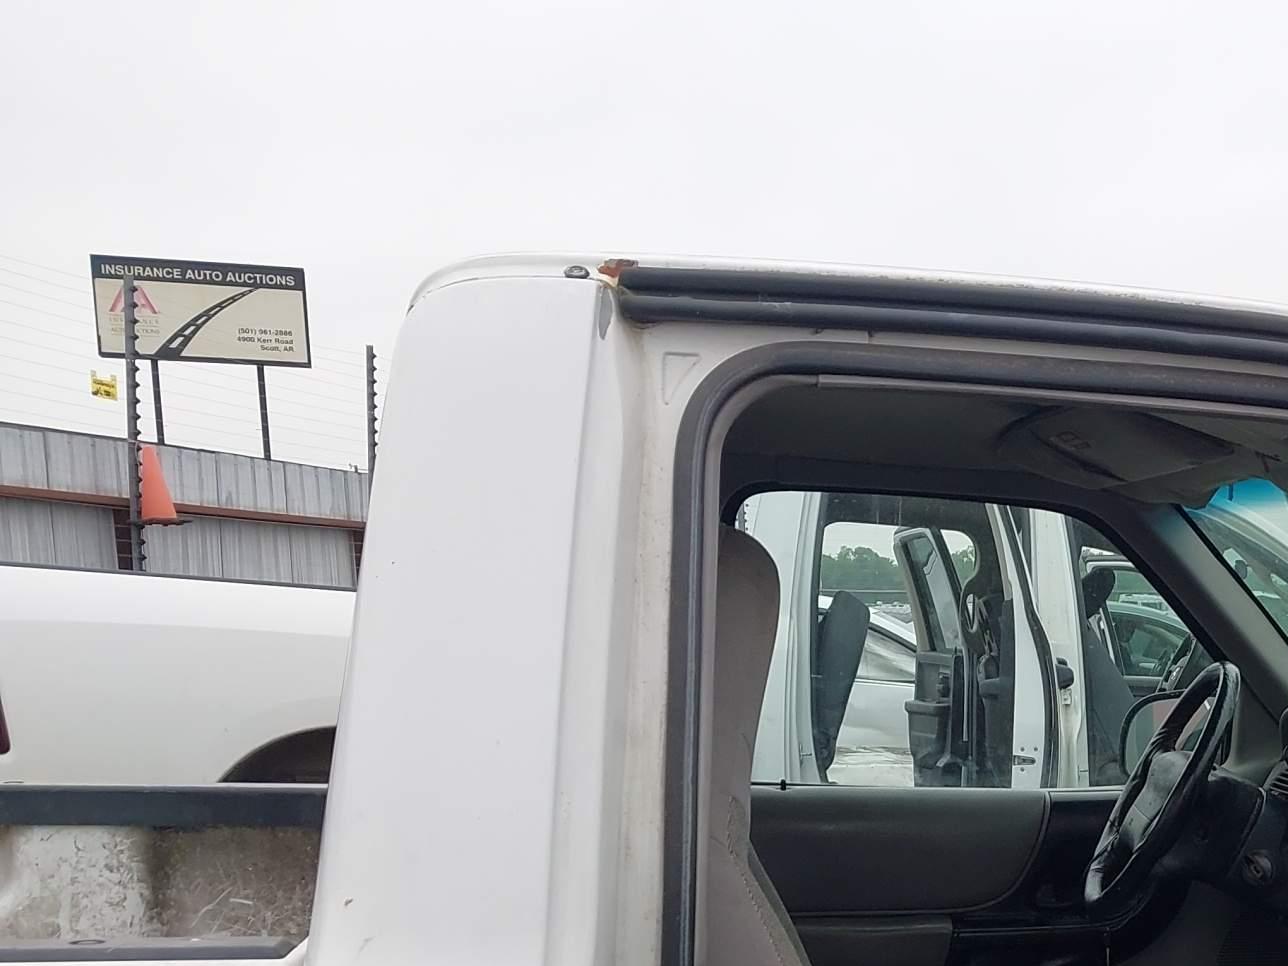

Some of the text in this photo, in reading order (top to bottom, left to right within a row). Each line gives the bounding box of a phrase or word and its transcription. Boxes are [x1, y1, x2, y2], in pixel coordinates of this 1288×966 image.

[101, 263, 296, 287] INSURANCE AUTO AUCTIONS
[274, 337, 294, 345] Road
